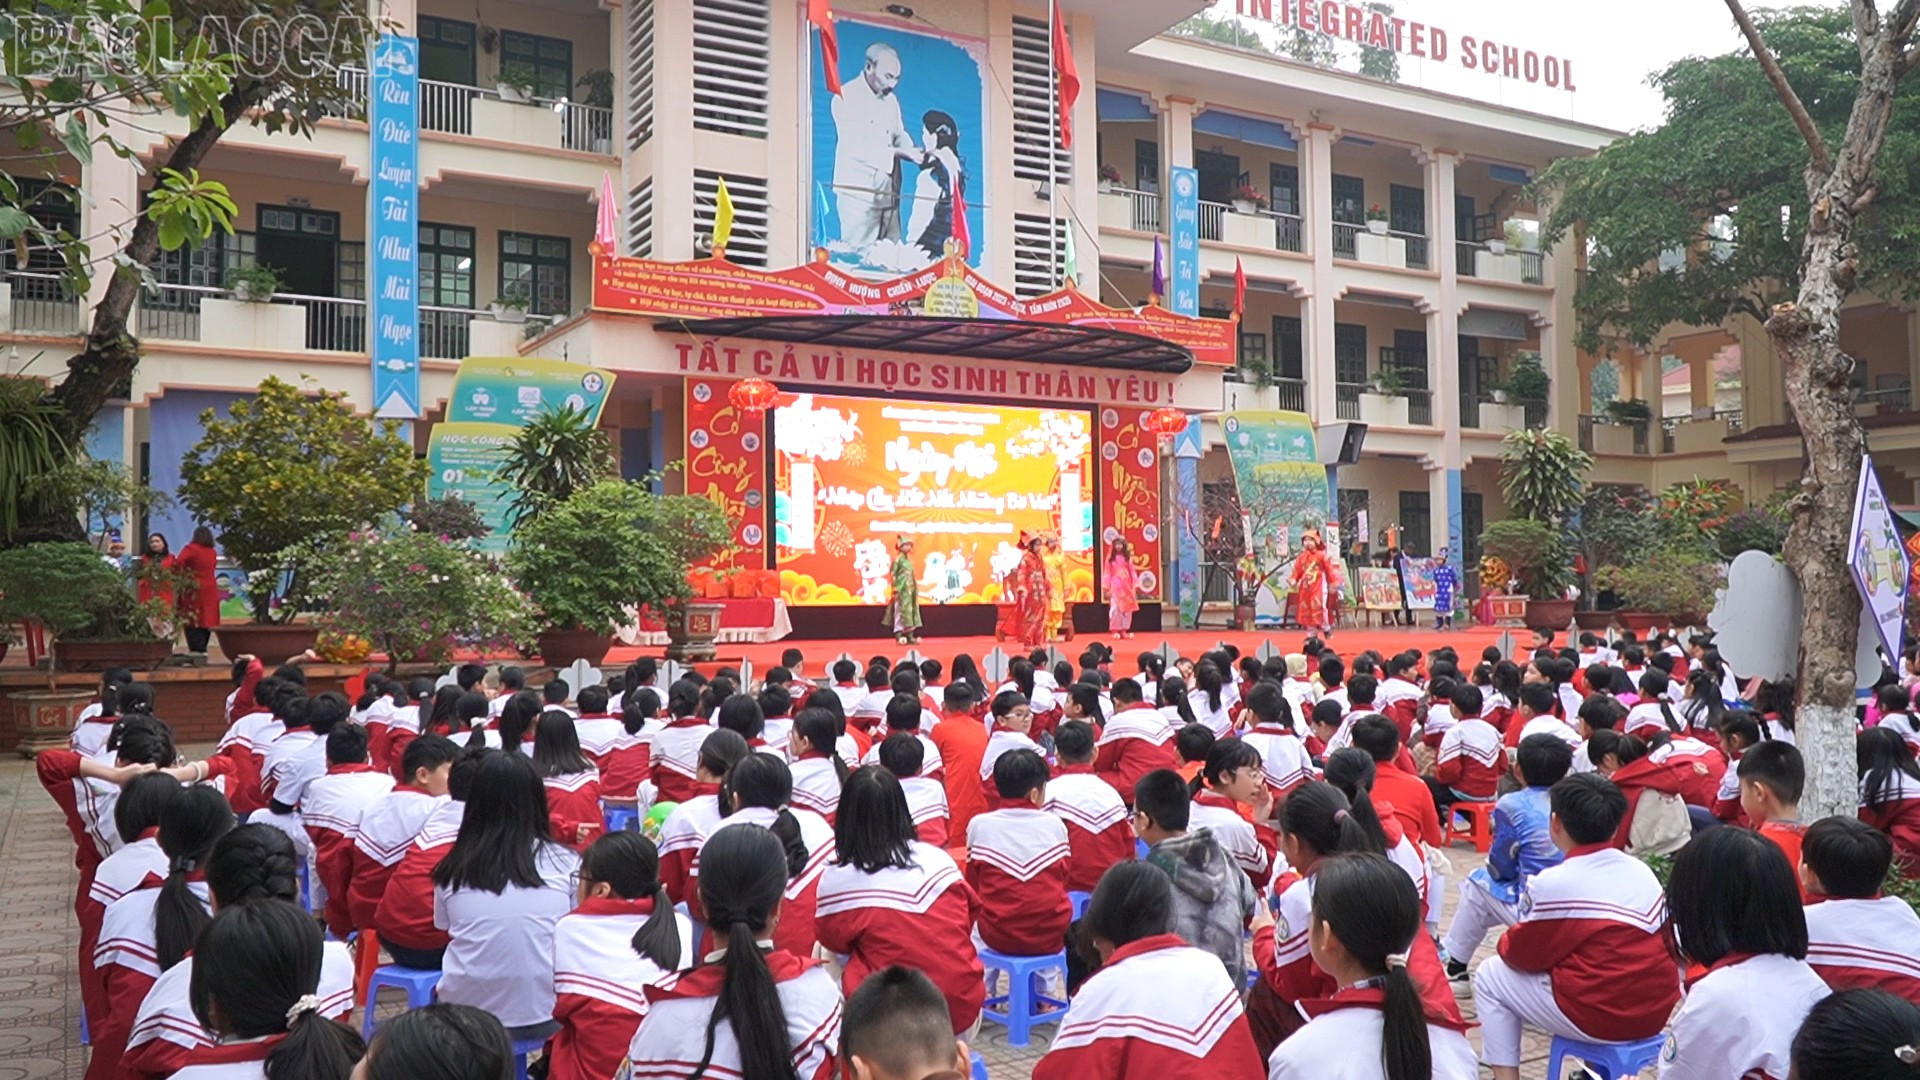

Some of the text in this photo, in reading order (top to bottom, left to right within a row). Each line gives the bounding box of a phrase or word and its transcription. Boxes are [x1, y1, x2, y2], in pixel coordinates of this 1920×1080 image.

[1461, 35, 1577, 92] SCHOOL
[378, 79, 412, 346] Rèn Đức Luyện Tài Như Mài Ngọc
[849, 282, 881, 299] HƯỚNG
[886, 279, 912, 298] CHIẾN
[675, 337, 1175, 403] TẤT CẢ VÌ HỌC SINH THÂN YÊU !
[442, 435, 467, 444] HỌC
[710, 406, 741, 436] Có
[1116, 423, 1140, 450] Có
[442, 469, 464, 483] 01
[692, 446, 755, 493] Công
[886, 437, 998, 486] Ngày Hội
[1112, 460, 1158, 506] Ngày
[1114, 500, 1144, 534] Nên
